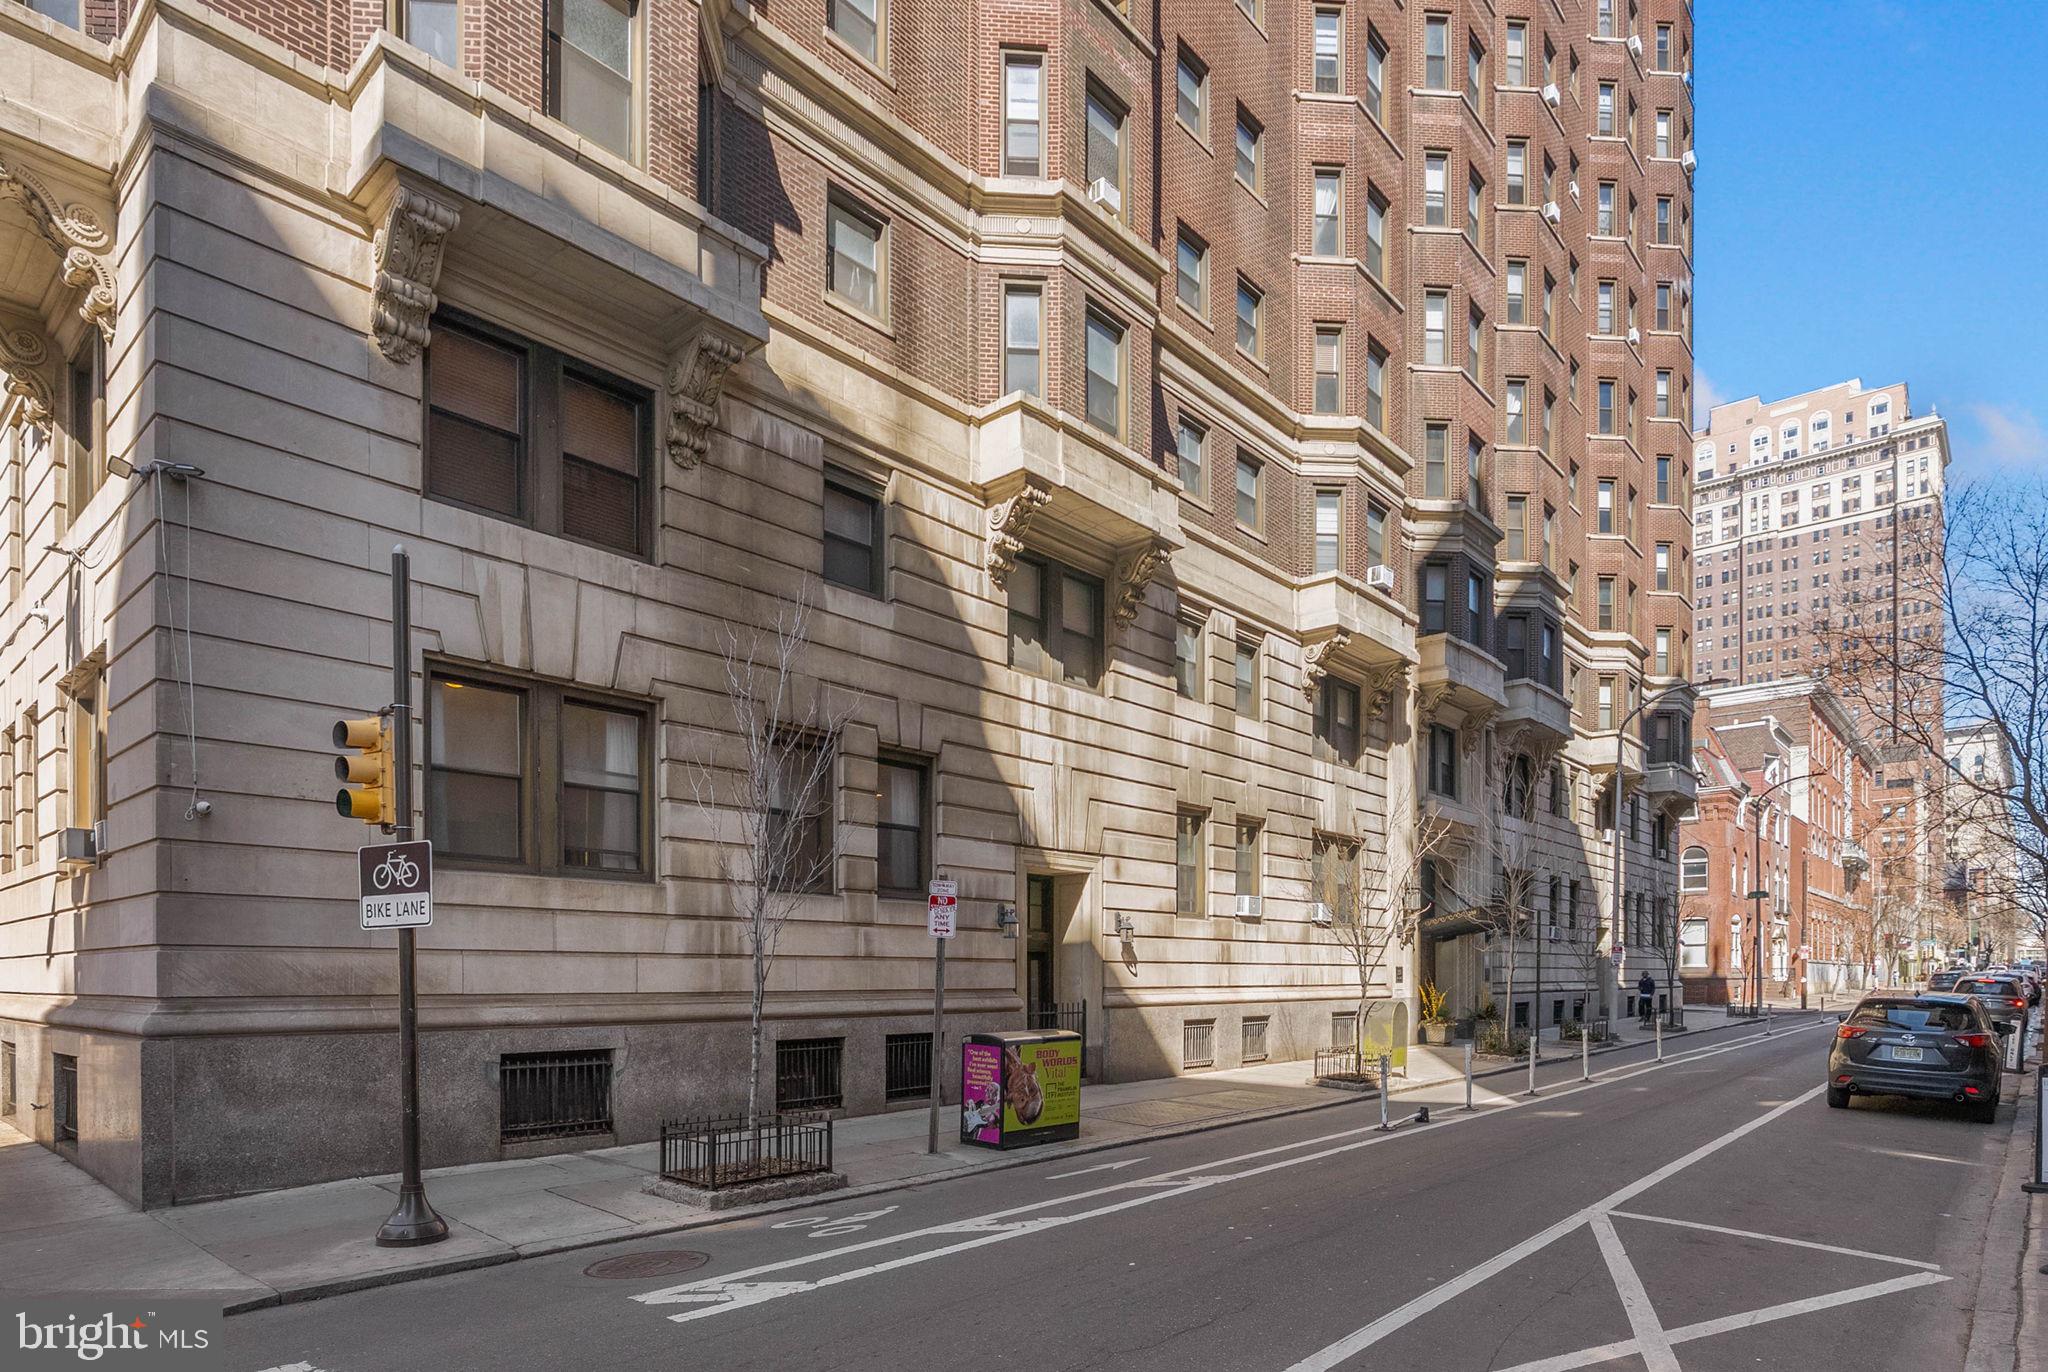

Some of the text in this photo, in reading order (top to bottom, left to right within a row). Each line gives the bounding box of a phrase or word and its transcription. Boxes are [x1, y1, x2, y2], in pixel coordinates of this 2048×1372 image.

[937, 896, 948, 905] NO
[366, 900, 425, 918] BIKE LANE
[1036, 1049, 1060, 1059] BODY
[1042, 1057, 1078, 1067] WORLDS
[1045, 1067, 1066, 1080] Vital
